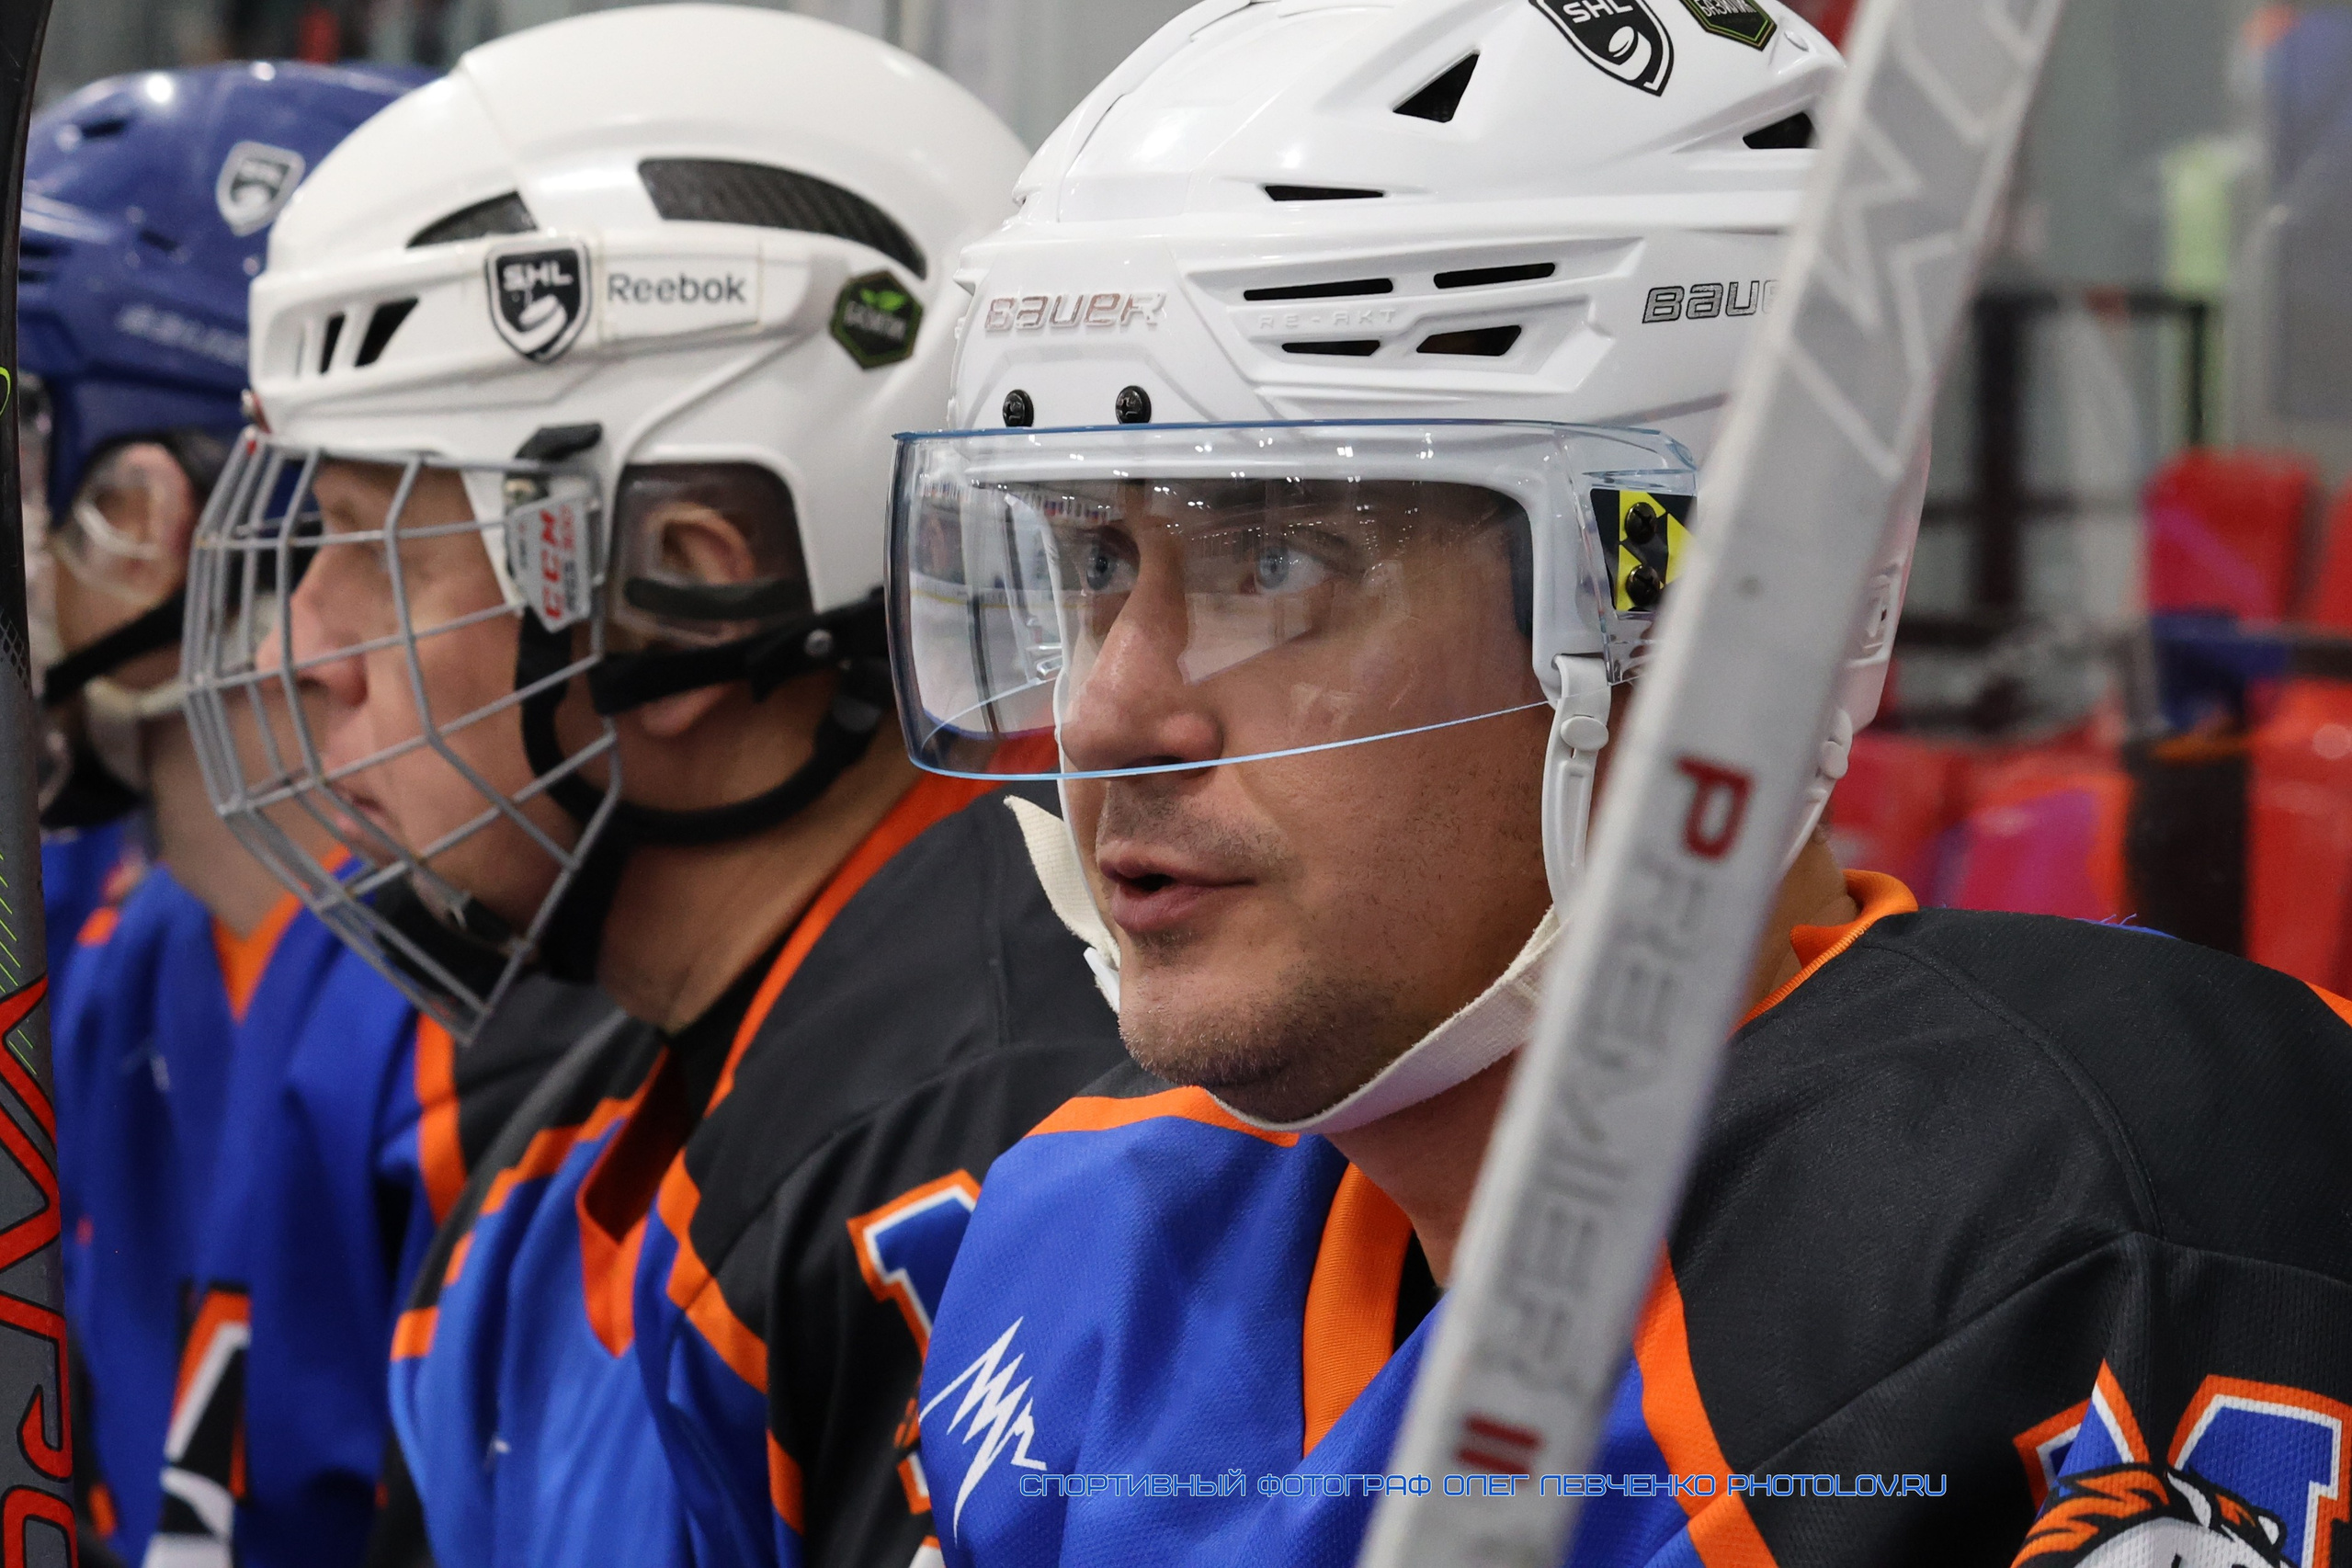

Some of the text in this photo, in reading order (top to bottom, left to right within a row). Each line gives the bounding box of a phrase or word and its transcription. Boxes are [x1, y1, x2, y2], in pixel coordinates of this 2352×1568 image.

[1562, 0, 1634, 24] SHL
[607, 272, 747, 304] Reebok
[984, 292, 1166, 332] BAUER
[539, 507, 565, 620] CCM
[1471, 756, 1755, 1406] PREMIER
